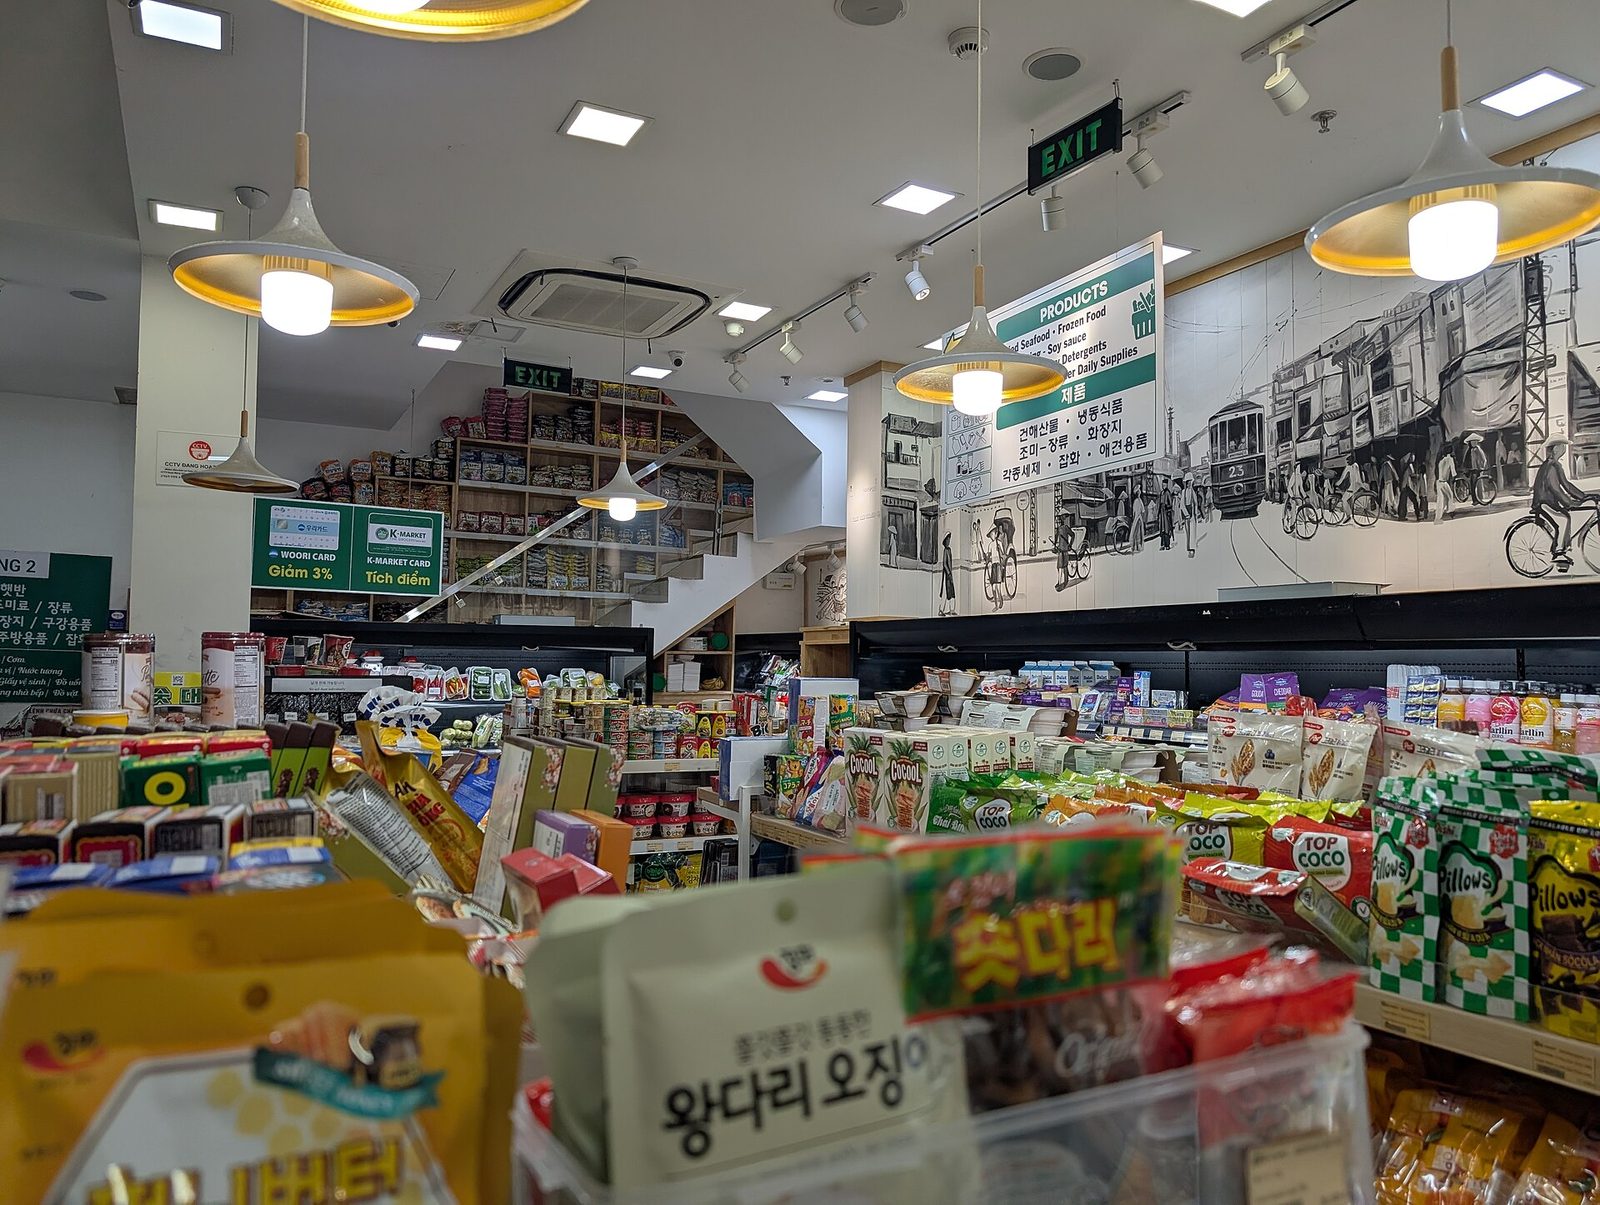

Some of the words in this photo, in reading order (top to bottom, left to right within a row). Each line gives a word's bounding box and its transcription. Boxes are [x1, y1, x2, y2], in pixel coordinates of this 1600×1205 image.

[1041, 118, 1102, 177] EXIT
[1039, 280, 1108, 323] PRODUCTS
[1020, 329, 1050, 350] Seafood
[1057, 317, 1085, 335] Frozen
[1085, 305, 1107, 324] Food
[1047, 342, 1062, 355] Soy
[1063, 332, 1087, 348] sauce
[1061, 340, 1107, 365] Detergents
[1077, 359, 1099, 377] Daily
[1099, 346, 1138, 368] Supplies
[515, 365, 561, 388] EXIT
[1061, 384, 1087, 405] 제품
[1019, 418, 1059, 443] 건해산물
[1077, 398, 1123, 425] 냉동식품
[1087, 418, 1122, 441] 화장지
[1002, 461, 1041, 482] 각종세제
[1058, 450, 1081, 469] 잡화
[1099, 432, 1148, 458] 애견용품
[1227, 466, 1245, 479] 23
[306, 524, 328, 533] 우리카드
[280, 550, 311, 560] WOORI
[312, 552, 336, 562] CARD
[366, 556, 409, 567] K-MARKET
[409, 559, 431, 568] CARD
[26, 559, 36, 573] 2
[268, 563, 308, 579] Giảm
[312, 566, 333, 580] 3%
[365, 570, 393, 584] Tích
[397, 570, 431, 586] điểm
[0, 582, 27, 598] 햇반
[47, 601, 73, 615] 장류
[42, 617, 92, 631] 구강용품
[6, 655, 26, 663] Cơm
[17, 666, 39, 675] Nước
[28, 678, 46, 686] sinh
[12, 688, 29, 696] nhà
[30, 688, 44, 698] bếp
[982, 806, 1006, 817] TOP
[979, 815, 1007, 829] COCO
[1189, 834, 1226, 851] OCO
[1304, 836, 1338, 850] TOP
[1297, 850, 1345, 867] COCO
[1372, 854, 1407, 882] Pillows
[1439, 864, 1492, 892] Pillows
[662, 1058, 814, 1160] 왕다리
